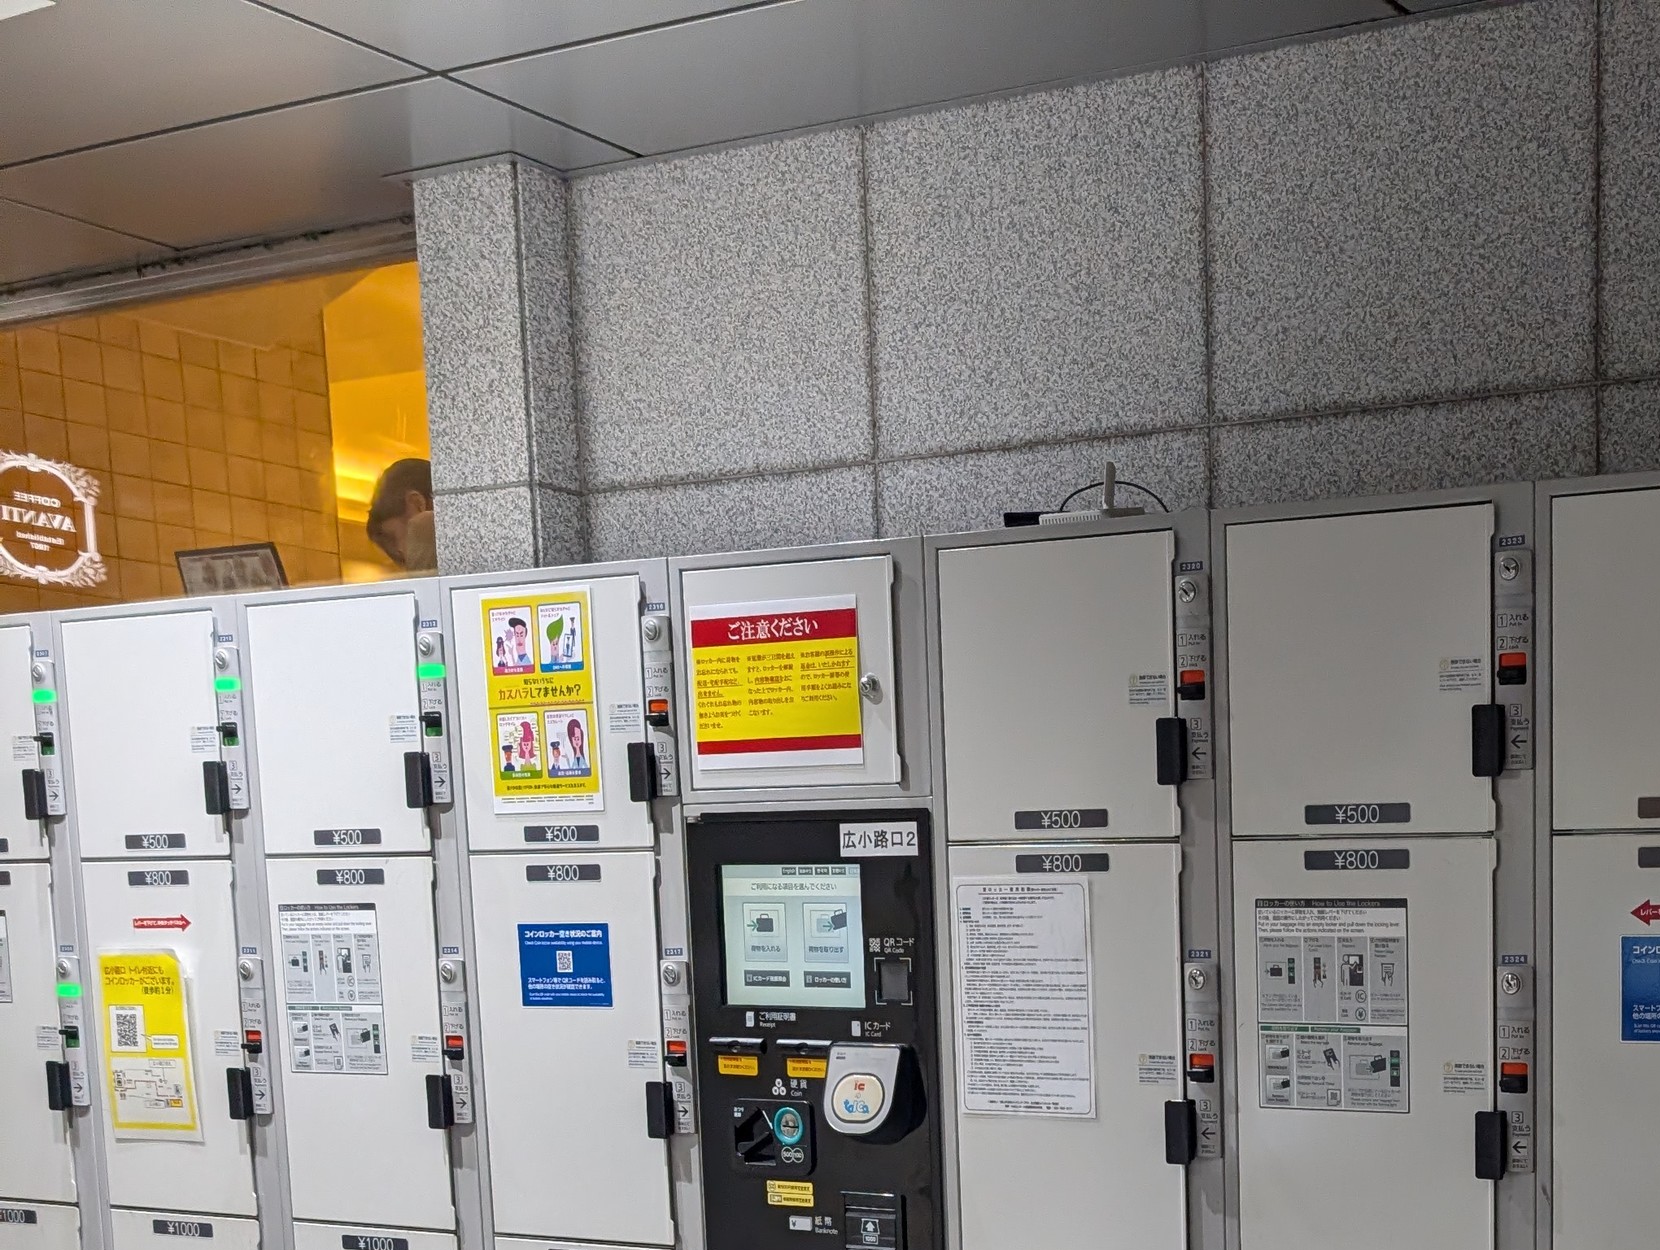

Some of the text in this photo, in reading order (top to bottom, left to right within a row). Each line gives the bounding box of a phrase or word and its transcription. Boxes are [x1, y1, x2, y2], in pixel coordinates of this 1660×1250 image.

[1501, 536, 1523, 546] 2323
[1181, 562, 1201, 571] 2320
[728, 618, 818, 640] ご注意ください
[1041, 811, 1080, 828] ¥500
[1335, 805, 1379, 823] ¥500
[333, 830, 362, 845] ¥500
[545, 826, 577, 841] ¥500
[842, 830, 917, 849] 広小路口2
[142, 835, 169, 849] ¥500
[1042, 855, 1081, 872] ¥800
[1334, 851, 1378, 869] ¥800
[145, 872, 171, 885] ¥800
[336, 870, 365, 884] ¥800
[547, 866, 579, 880] ¥800
[750, 883, 837, 891] ご利用になる項目を選んでください
[1190, 950, 1209, 958] 2321
[1504, 955, 1525, 963] 2324
[1511, 1026, 1531, 1035] 入れる
[1511, 1047, 1531, 1056] 下げる
[167, 1221, 199, 1236] ¥1000
[815, 1227, 839, 1235] Banknote
